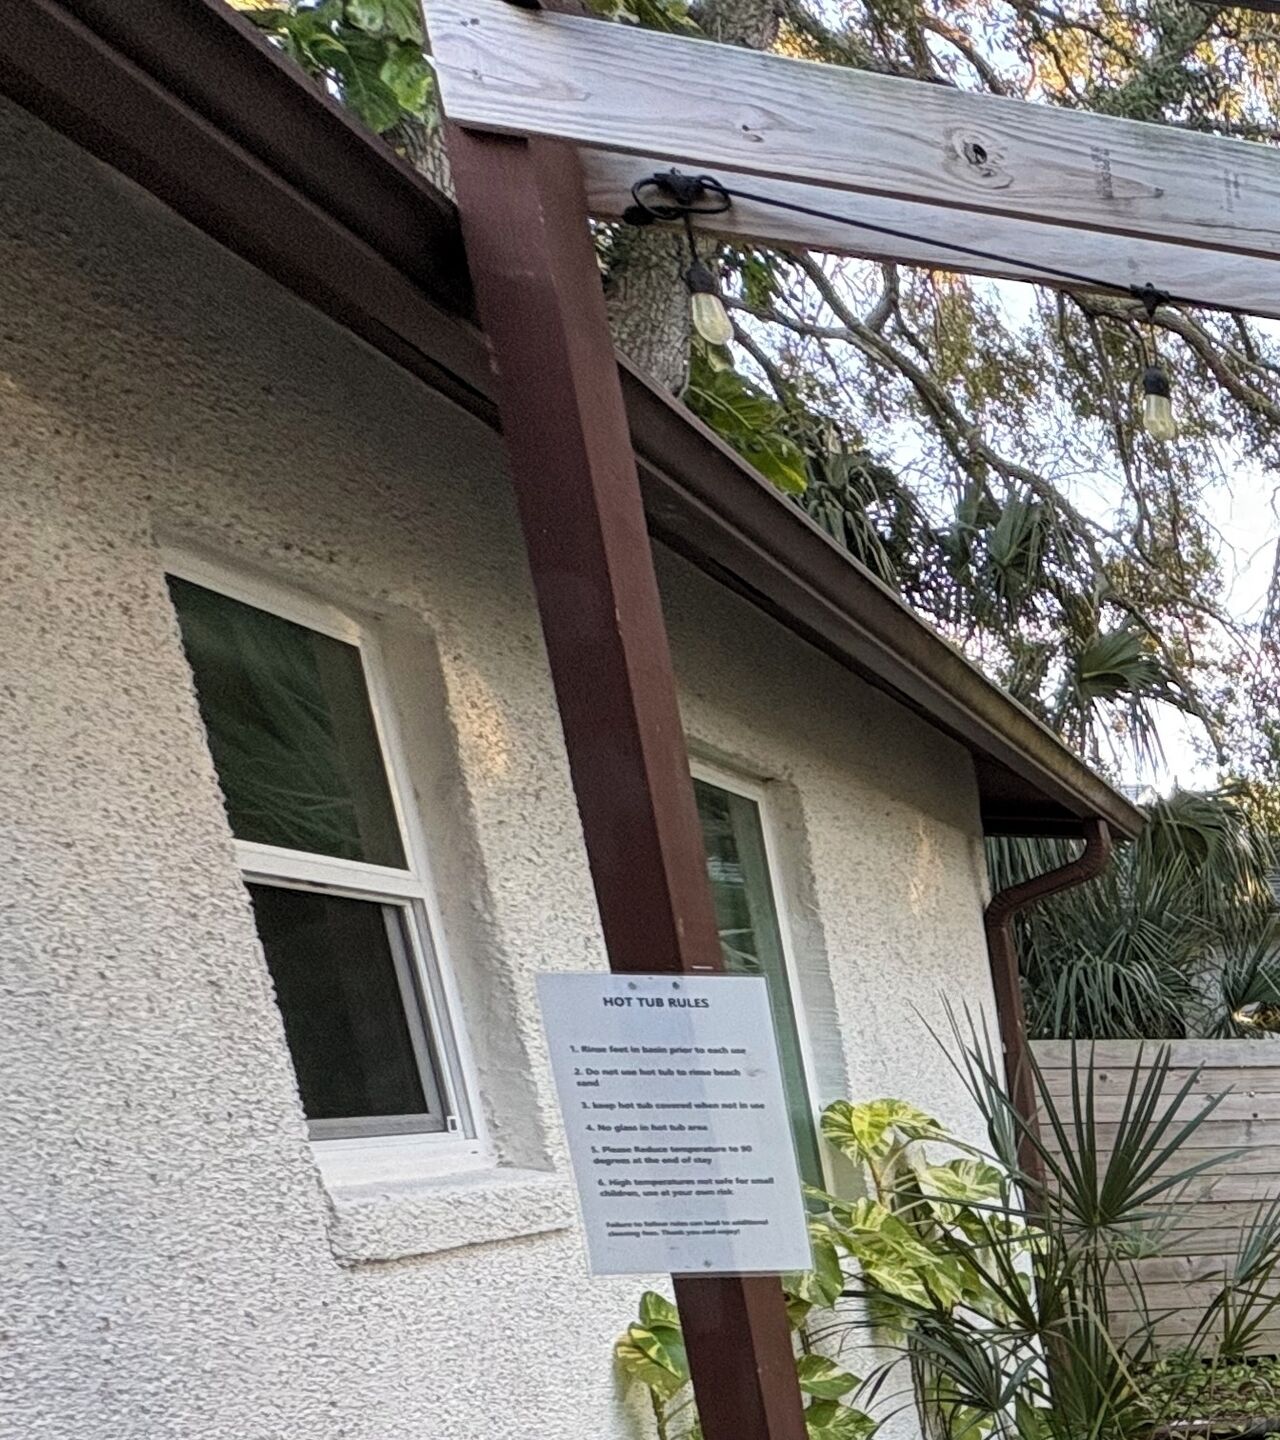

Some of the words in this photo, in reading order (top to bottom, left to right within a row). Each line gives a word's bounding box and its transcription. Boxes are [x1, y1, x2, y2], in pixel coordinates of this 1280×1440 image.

[603, 997, 633, 1007] HOT
[636, 997, 664, 1008] TUB
[668, 998, 710, 1008] RULES
[609, 1045, 629, 1053] feet
[670, 1046, 693, 1055] prior
[707, 1046, 729, 1054] each
[574, 1068, 583, 1076] 2.
[586, 1068, 599, 1076] Do
[639, 1068, 655, 1076] hot
[658, 1068, 674, 1076] tub
[637, 1102, 653, 1110] tub
[681, 1156, 692, 1164] of
